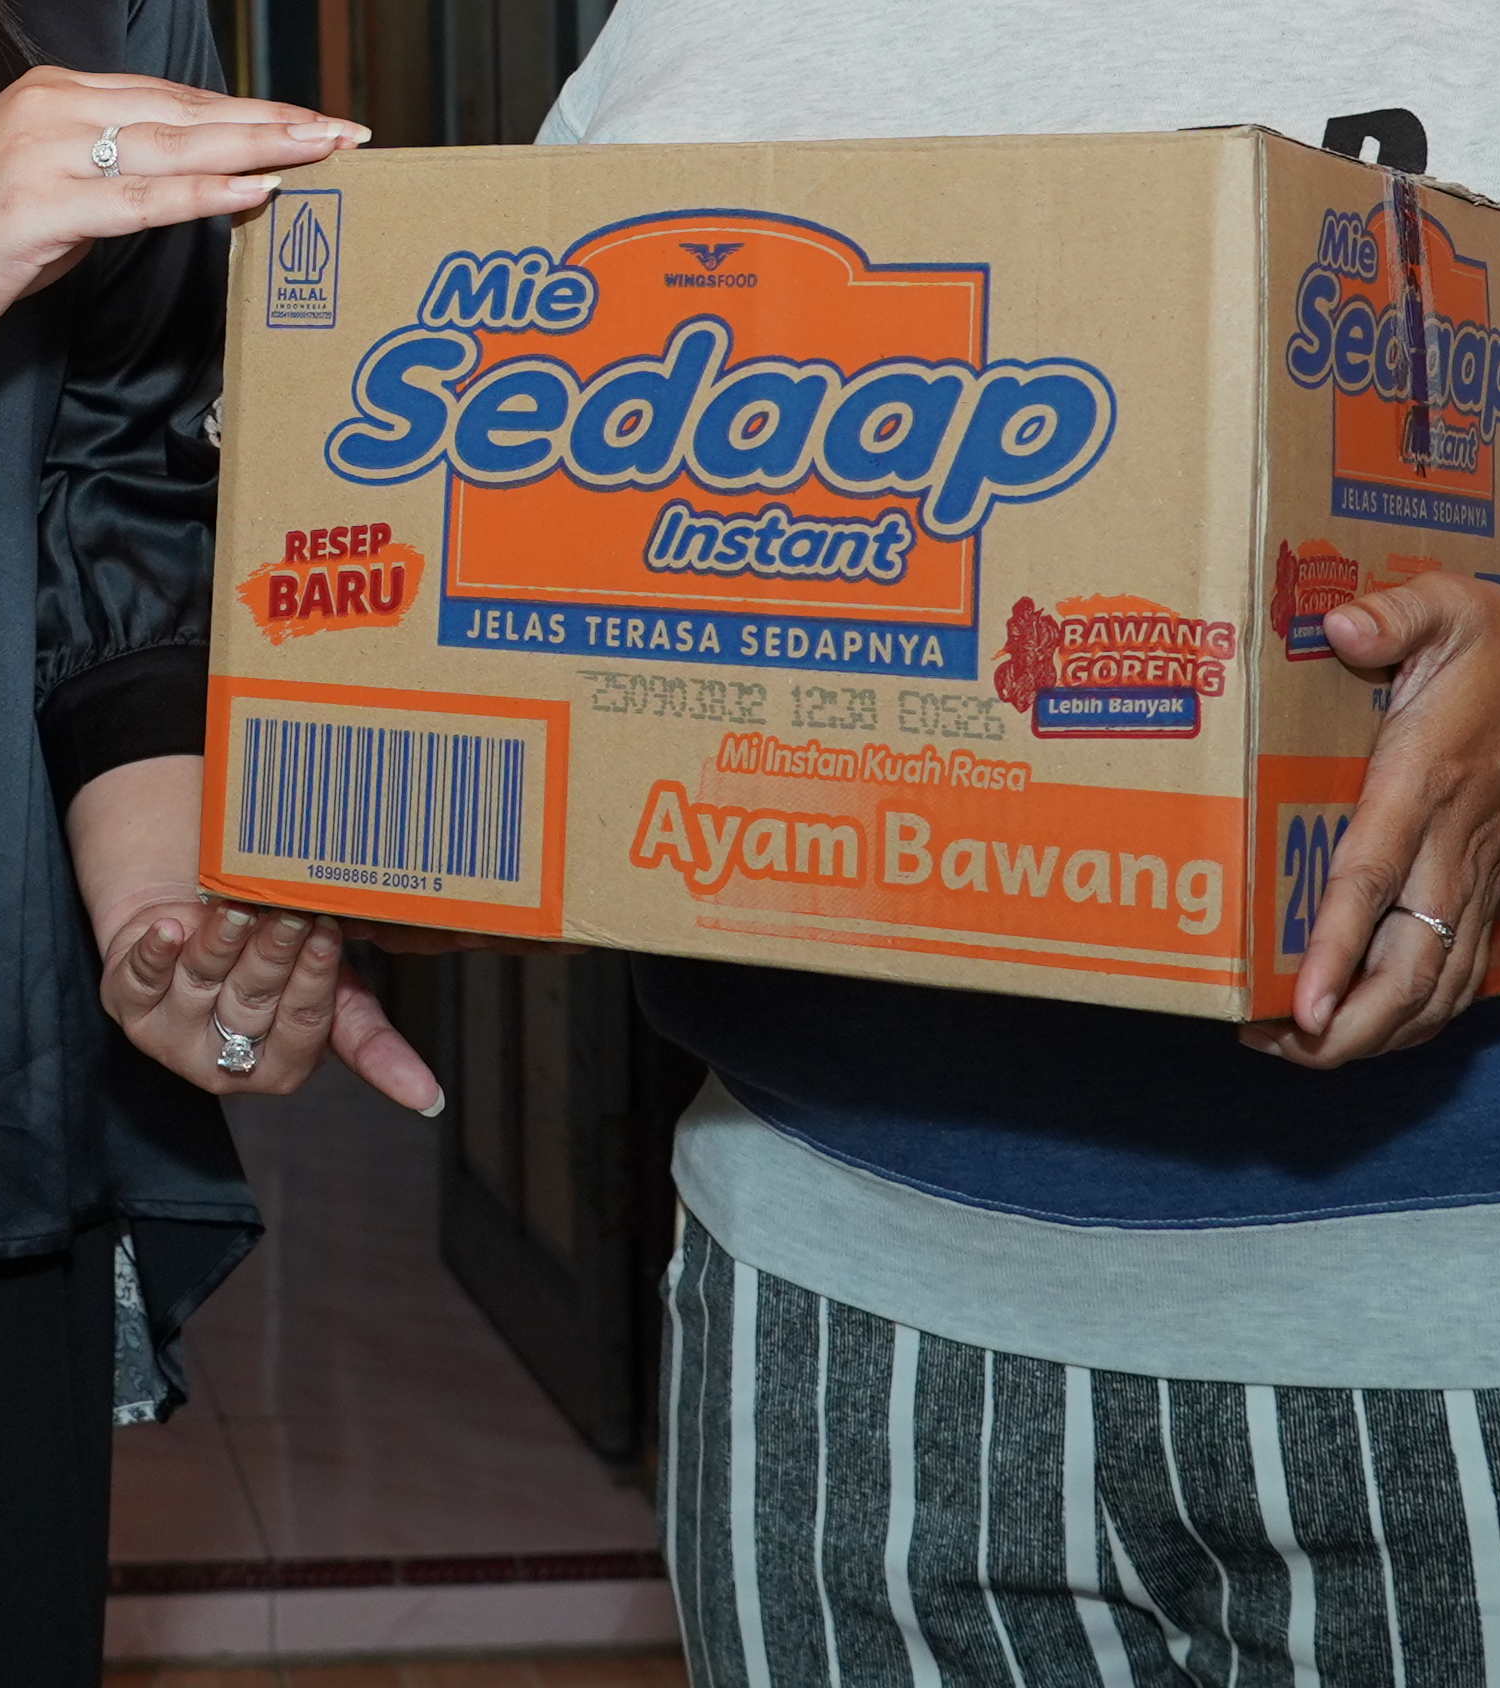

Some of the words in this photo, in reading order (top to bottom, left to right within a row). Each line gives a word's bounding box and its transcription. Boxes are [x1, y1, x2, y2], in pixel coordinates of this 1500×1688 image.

[1320, 214, 1377, 278] Mie
[277, 288, 327, 301] HALAL
[428, 256, 593, 328] Mie
[663, 273, 758, 288] WINGSFOOD
[334, 323, 1102, 532] Sedaap
[1341, 487, 1377, 513] JELAS
[1382, 493, 1428, 520] TERASA
[1433, 500, 1488, 529] SEDAPNYA
[284, 522, 392, 563] RESEP
[650, 506, 908, 578] Instant
[267, 562, 406, 621] BARU
[1299, 560, 1357, 585] BAWANG
[466, 608, 567, 644] JELAS
[585, 615, 721, 654] TERASA
[740, 624, 945, 669] SEDAPNYA
[1062, 619, 1233, 656] BAWANG
[1064, 657, 1222, 694] GORENG
[1048, 697, 1102, 715] Lebih
[1108, 697, 1185, 719] Banyak
[720, 738, 758, 773] Mi
[763, 742, 856, 780] Instan
[861, 747, 942, 786] Kuah
[949, 757, 1029, 792] Rasa
[307, 863, 378, 885] 18998866
[382, 872, 427, 890] 20031
[433, 877, 443, 892] 5
[639, 790, 860, 885] Ayam
[881, 810, 1224, 933] Bawang
